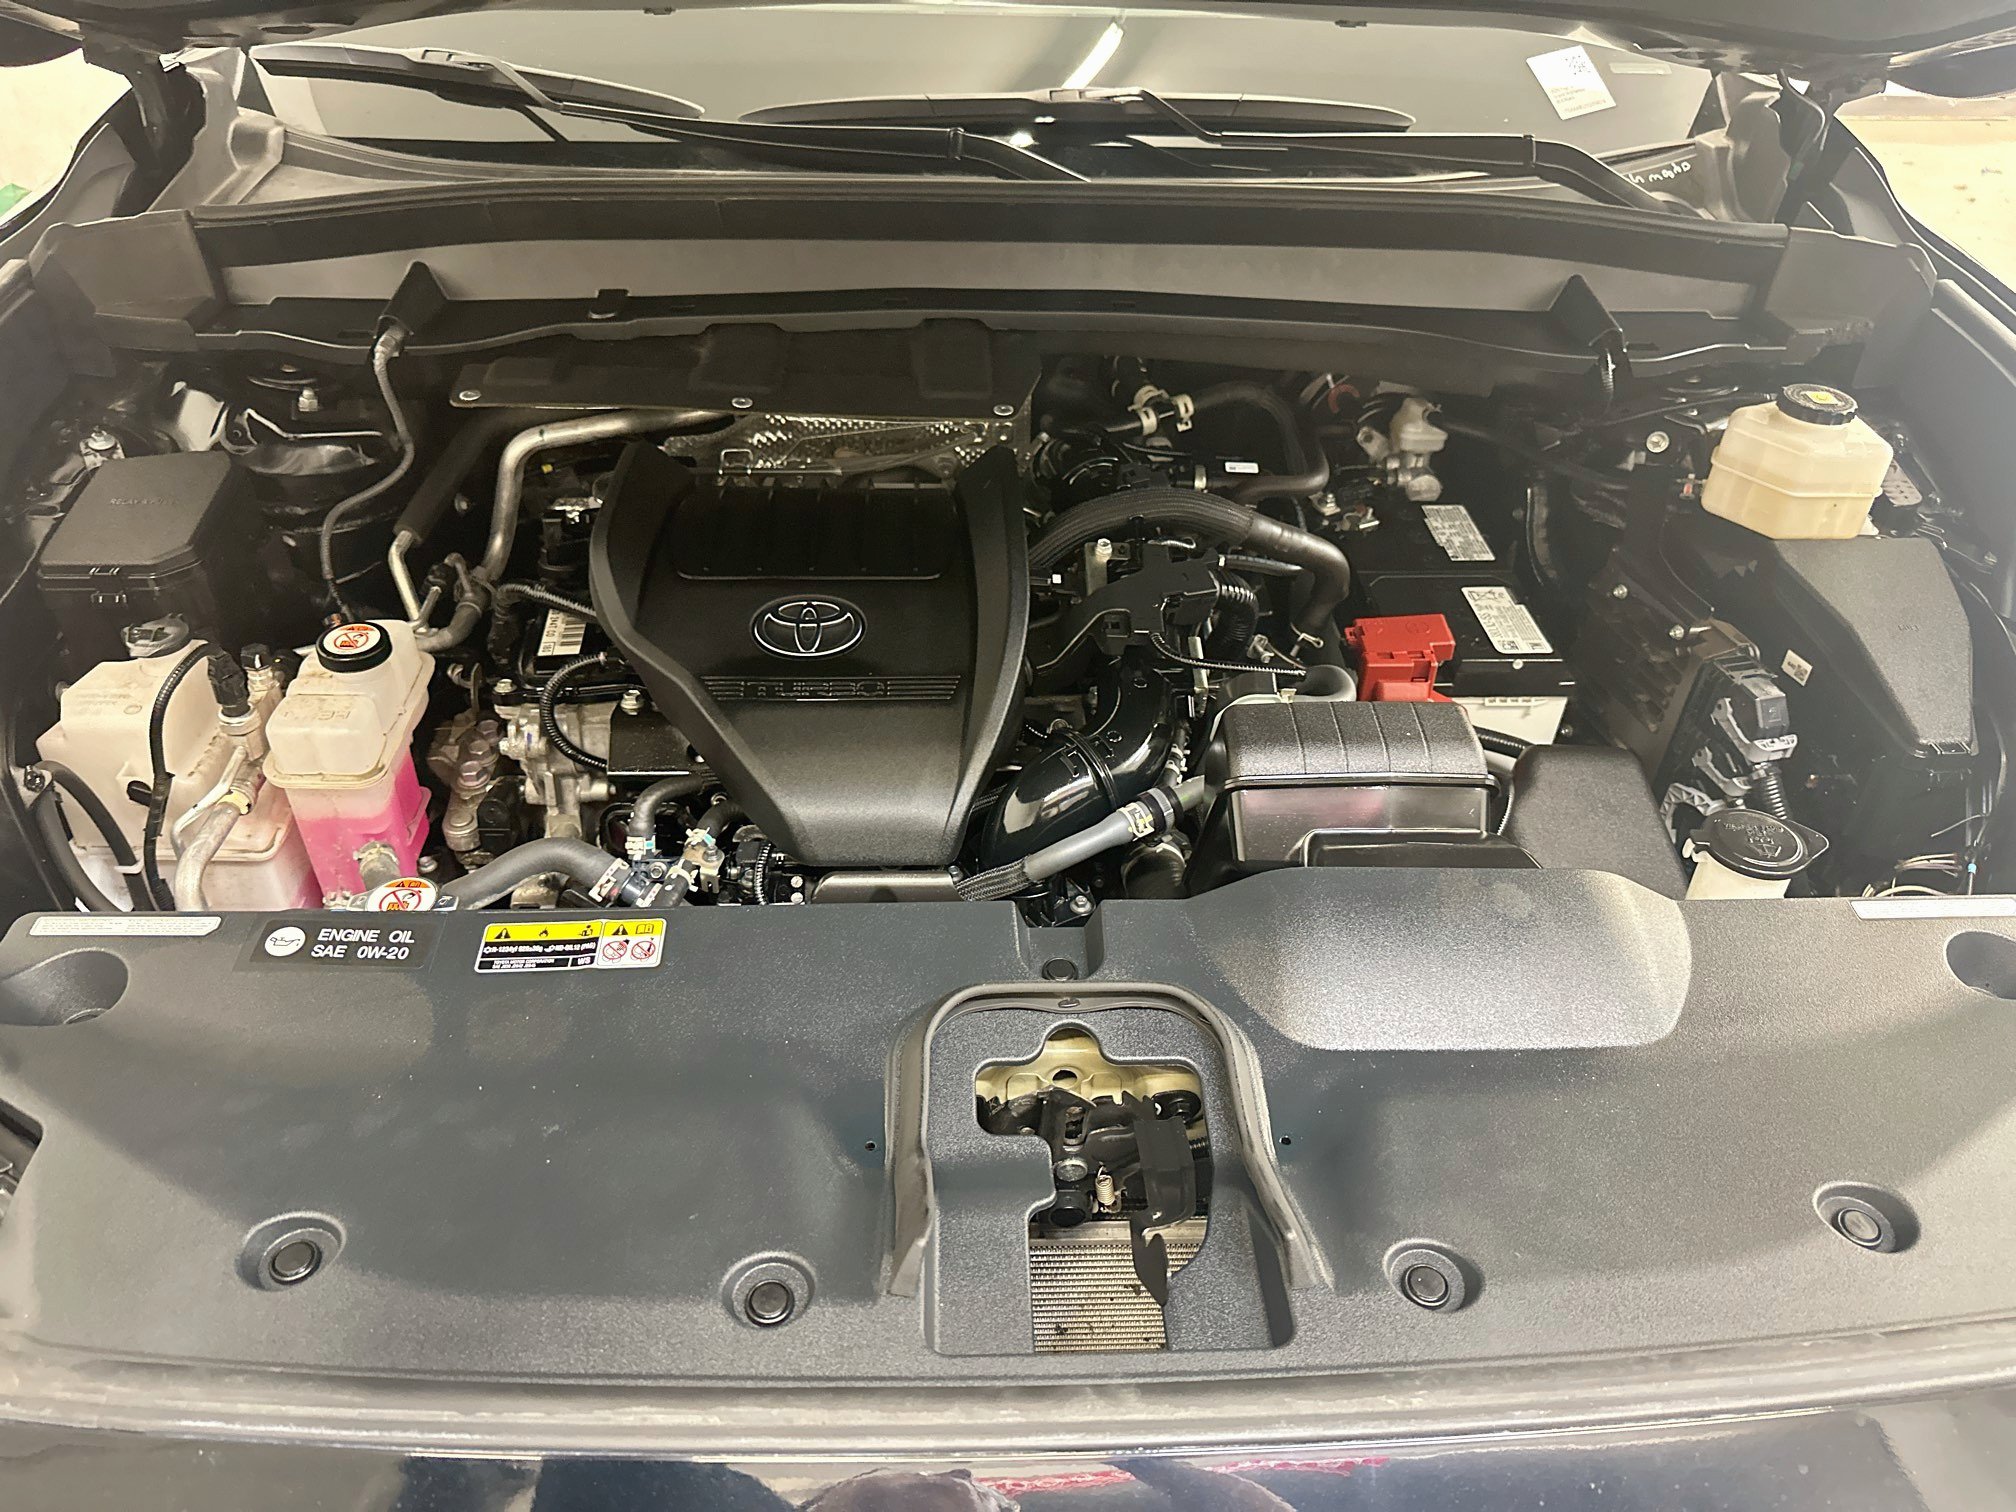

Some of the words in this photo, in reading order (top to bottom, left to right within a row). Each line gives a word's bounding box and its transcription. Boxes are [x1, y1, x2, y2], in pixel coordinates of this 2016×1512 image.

[747, 680, 884, 697] TURBO
[317, 928, 380, 943] ENGINE
[388, 930, 415, 944] OIL
[311, 944, 348, 958] SAE
[356, 945, 410, 960] 0W-20
